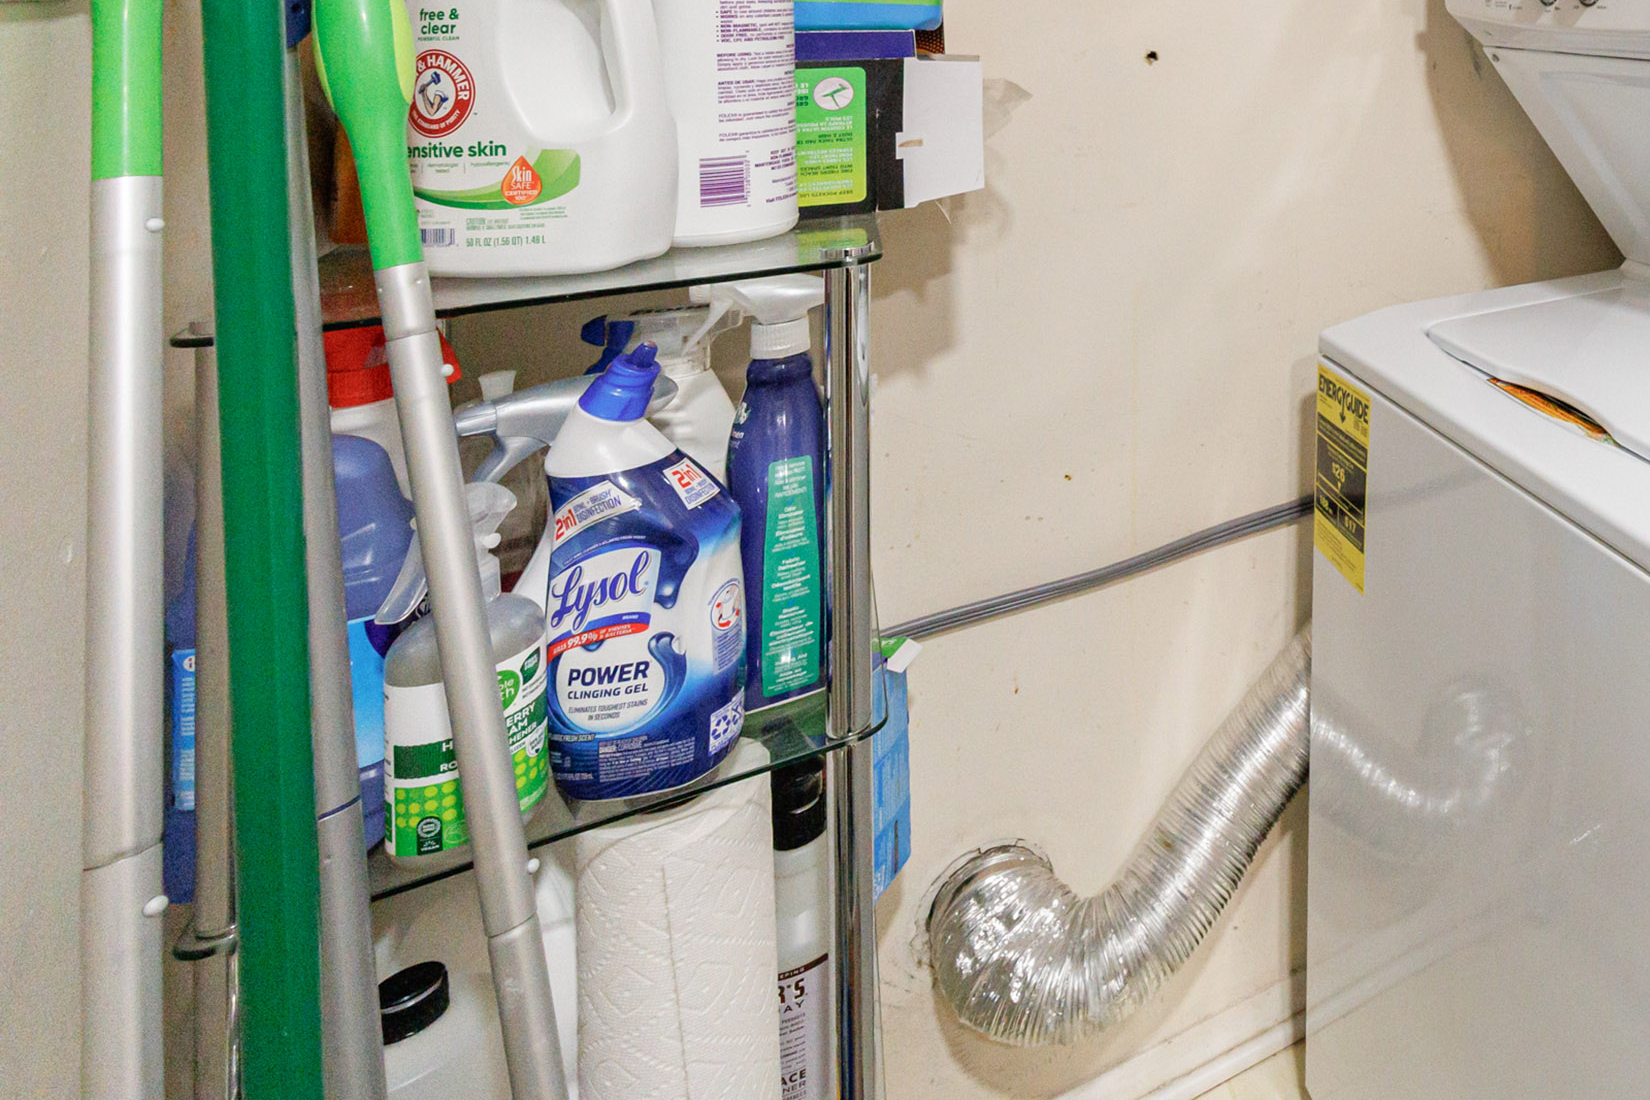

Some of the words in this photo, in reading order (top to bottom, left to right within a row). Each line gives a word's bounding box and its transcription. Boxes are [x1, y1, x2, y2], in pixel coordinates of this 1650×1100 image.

[420, 8, 445, 22] free
[449, 8, 459, 20] &
[421, 22, 456, 35] clear
[417, 60, 427, 73] &
[426, 54, 470, 101] HAMMER
[467, 140, 507, 157] skin
[511, 165, 532, 183] Skin
[466, 237, 474, 247] 50
[475, 237, 482, 247] FL
[483, 237, 492, 246] OZ
[541, 235, 546, 244] L
[1319, 373, 1369, 424] ENERGYGUIDE
[672, 464, 702, 489] 2in1
[576, 495, 622, 523] DISINFECTION
[556, 509, 577, 541] 2in1
[551, 550, 649, 631] Lysol
[568, 660, 650, 687] POWER
[567, 687, 621, 700] CLINGING
[624, 683, 648, 695] GEL
[568, 705, 597, 714] ELIMINATES
[598, 702, 626, 711] TOUGHEST
[627, 699, 648, 709] STAINS
[594, 712, 620, 720] SECONDS
[509, 717, 528, 735] AM
